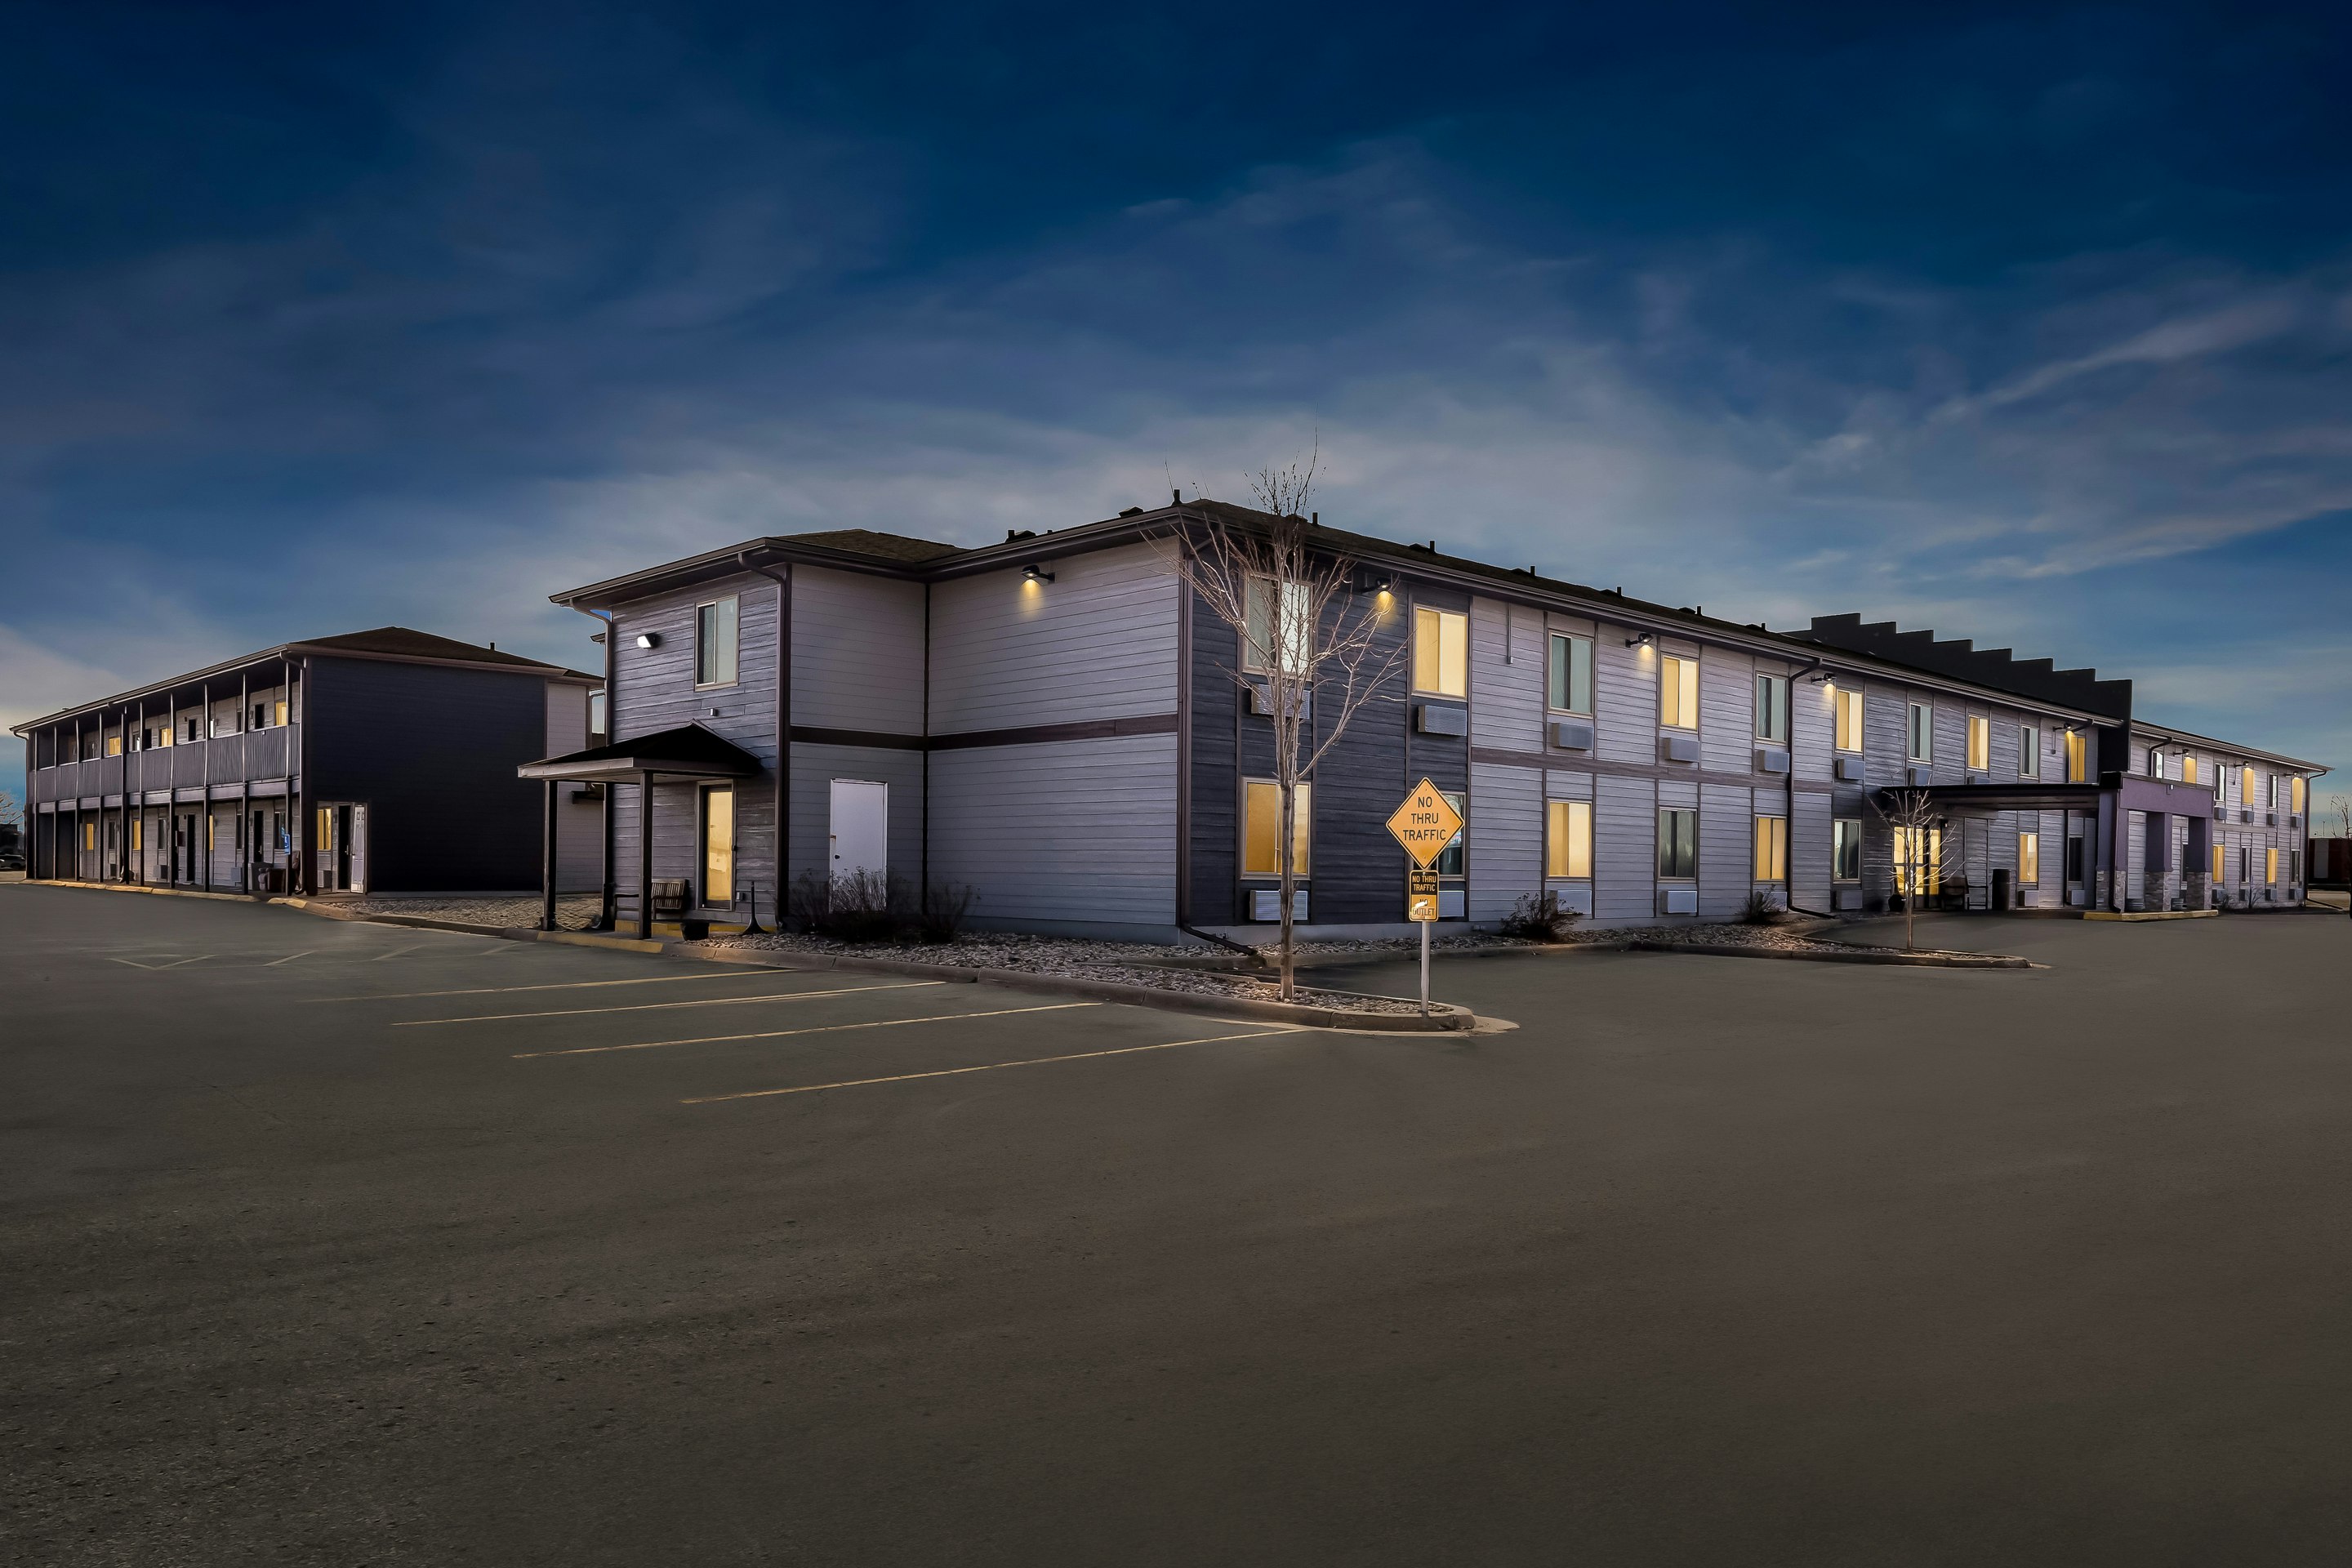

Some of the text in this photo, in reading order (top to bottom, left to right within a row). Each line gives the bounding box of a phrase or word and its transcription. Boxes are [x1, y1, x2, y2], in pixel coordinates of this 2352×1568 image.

[1418, 796, 1432, 808] NO
[1411, 813, 1439, 824] THRU
[1403, 829, 1446, 840] TRAFFIC
[1413, 884, 1436, 892] TRAFFIC
